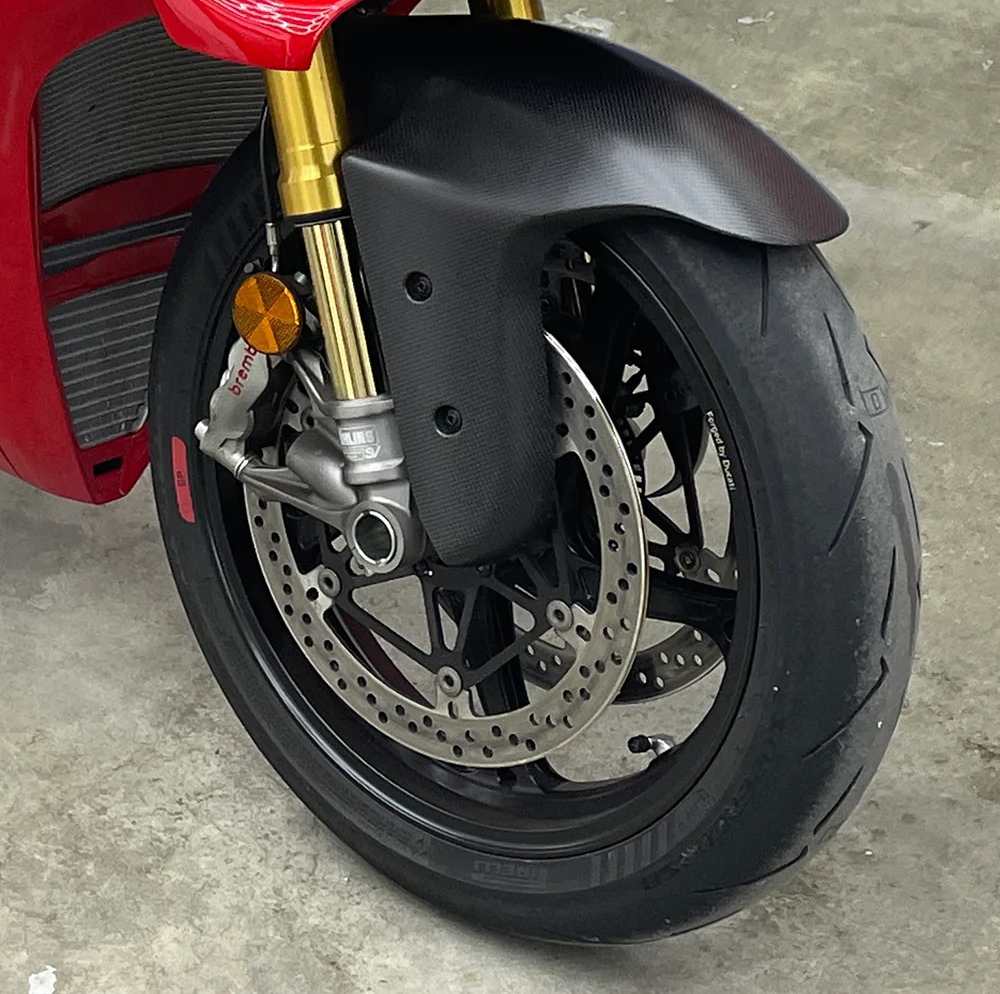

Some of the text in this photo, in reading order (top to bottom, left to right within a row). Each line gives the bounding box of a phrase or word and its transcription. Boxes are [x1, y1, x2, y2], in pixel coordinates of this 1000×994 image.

[227, 343, 259, 397] bremb
[705, 410, 736, 491] Forged by Ducati
